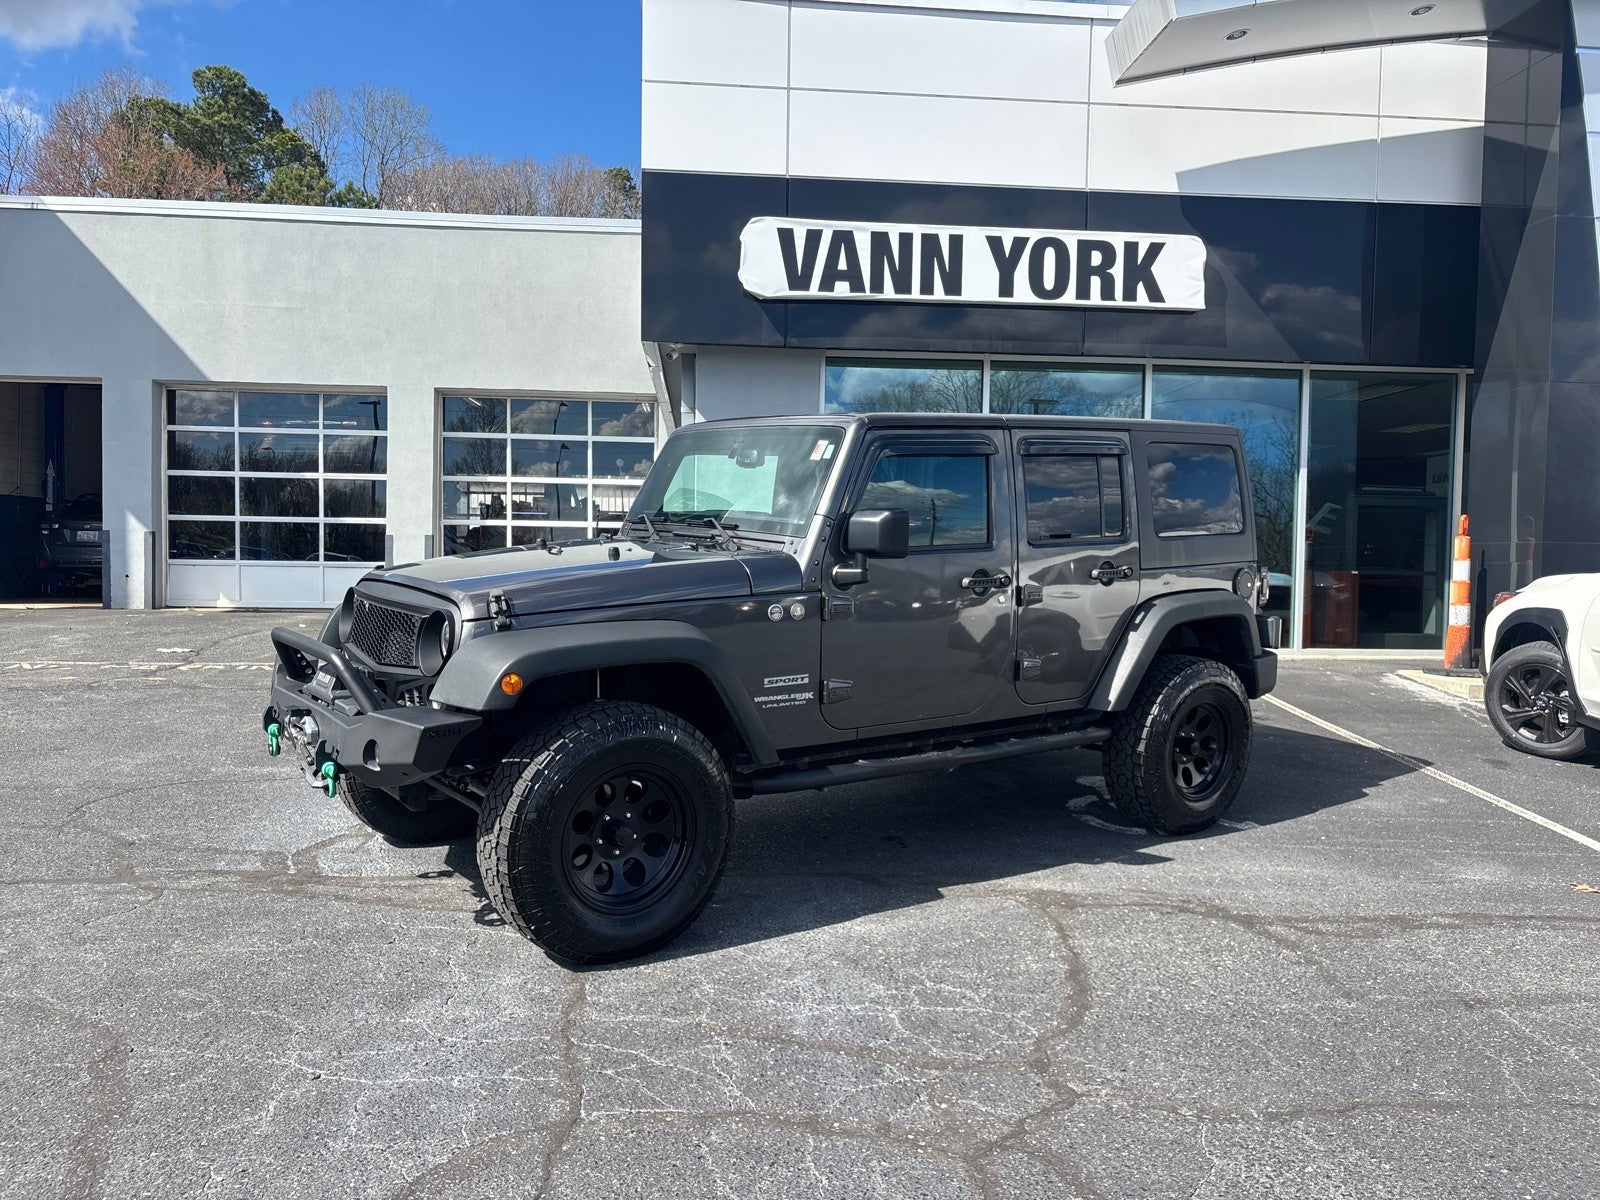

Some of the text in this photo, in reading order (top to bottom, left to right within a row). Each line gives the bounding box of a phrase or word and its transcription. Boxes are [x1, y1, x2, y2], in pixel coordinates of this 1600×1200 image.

[777, 227, 1166, 304] VANN YORK
[766, 676, 807, 685] SPORT
[754, 693, 801, 702] WRANGLER
[762, 700, 806, 708] UNLIMITED
